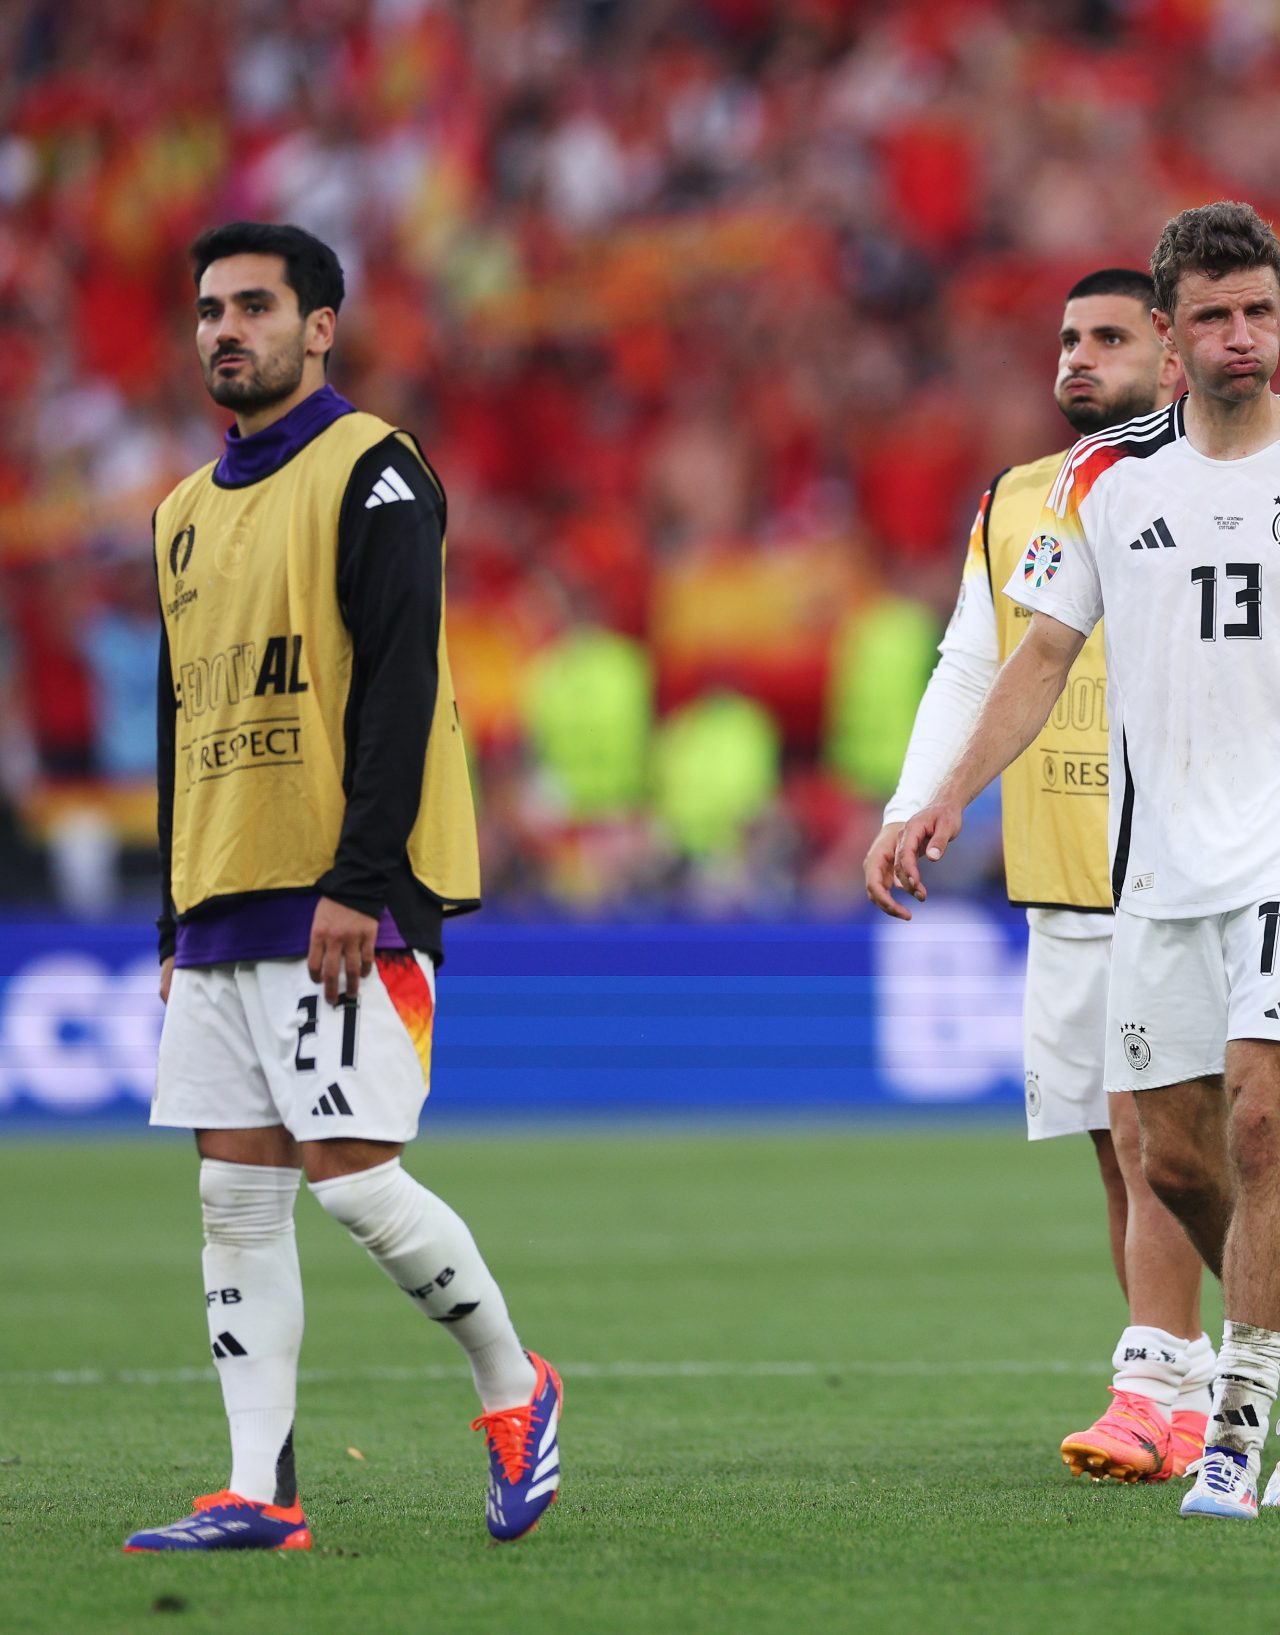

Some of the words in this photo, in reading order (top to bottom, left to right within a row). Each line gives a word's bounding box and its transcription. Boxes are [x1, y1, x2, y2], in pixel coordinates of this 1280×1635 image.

[1191, 563, 1262, 642] 13
[200, 728, 301, 771] RESPECT
[295, 994, 360, 1074] 21
[407, 1266, 456, 1300] FB
